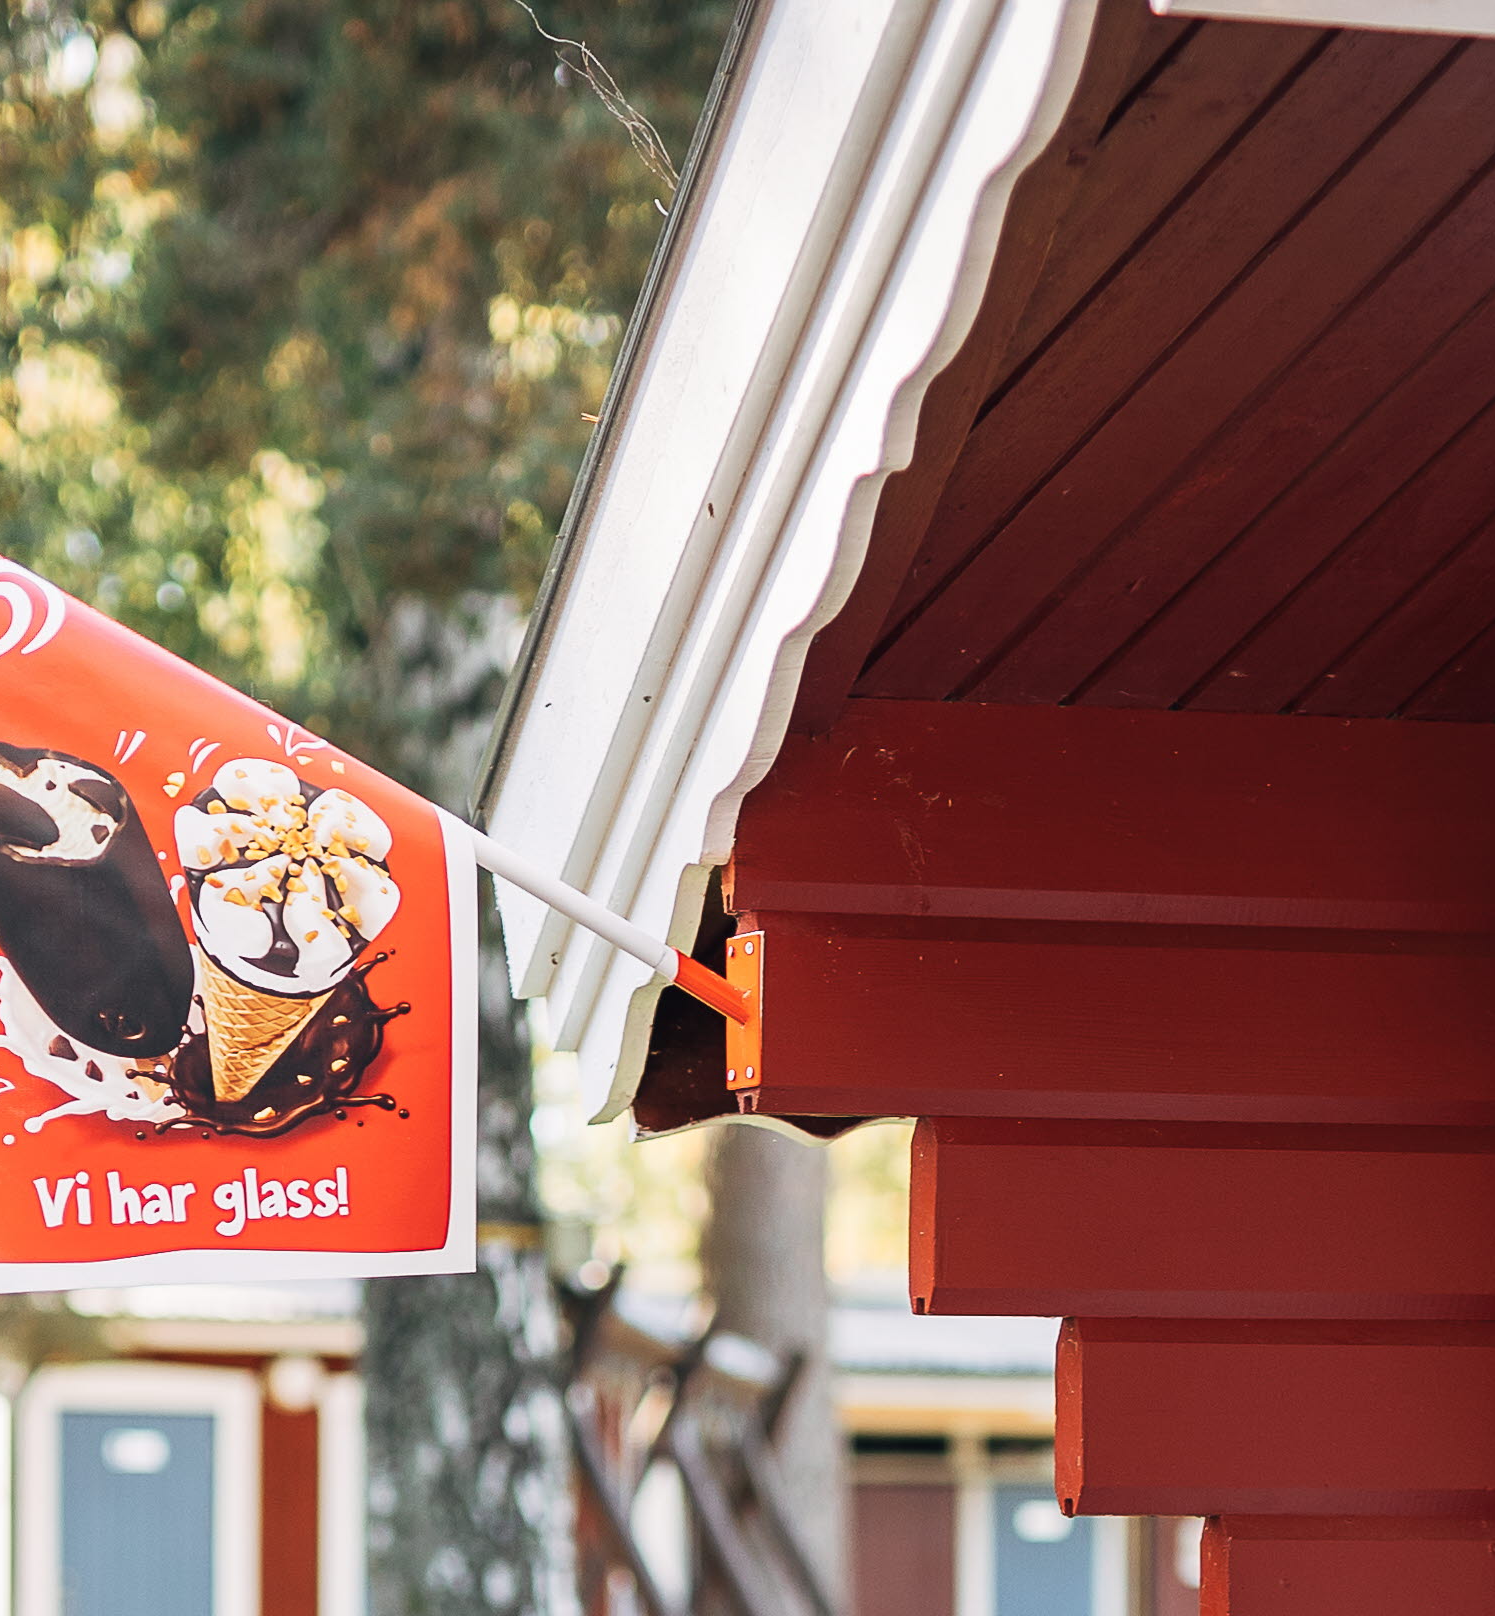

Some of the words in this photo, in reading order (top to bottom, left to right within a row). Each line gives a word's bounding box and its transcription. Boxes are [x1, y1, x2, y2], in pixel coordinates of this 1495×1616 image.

[33, 1171, 92, 1227] Vi
[107, 1171, 196, 1224] har
[213, 1167, 349, 1236] glass!
